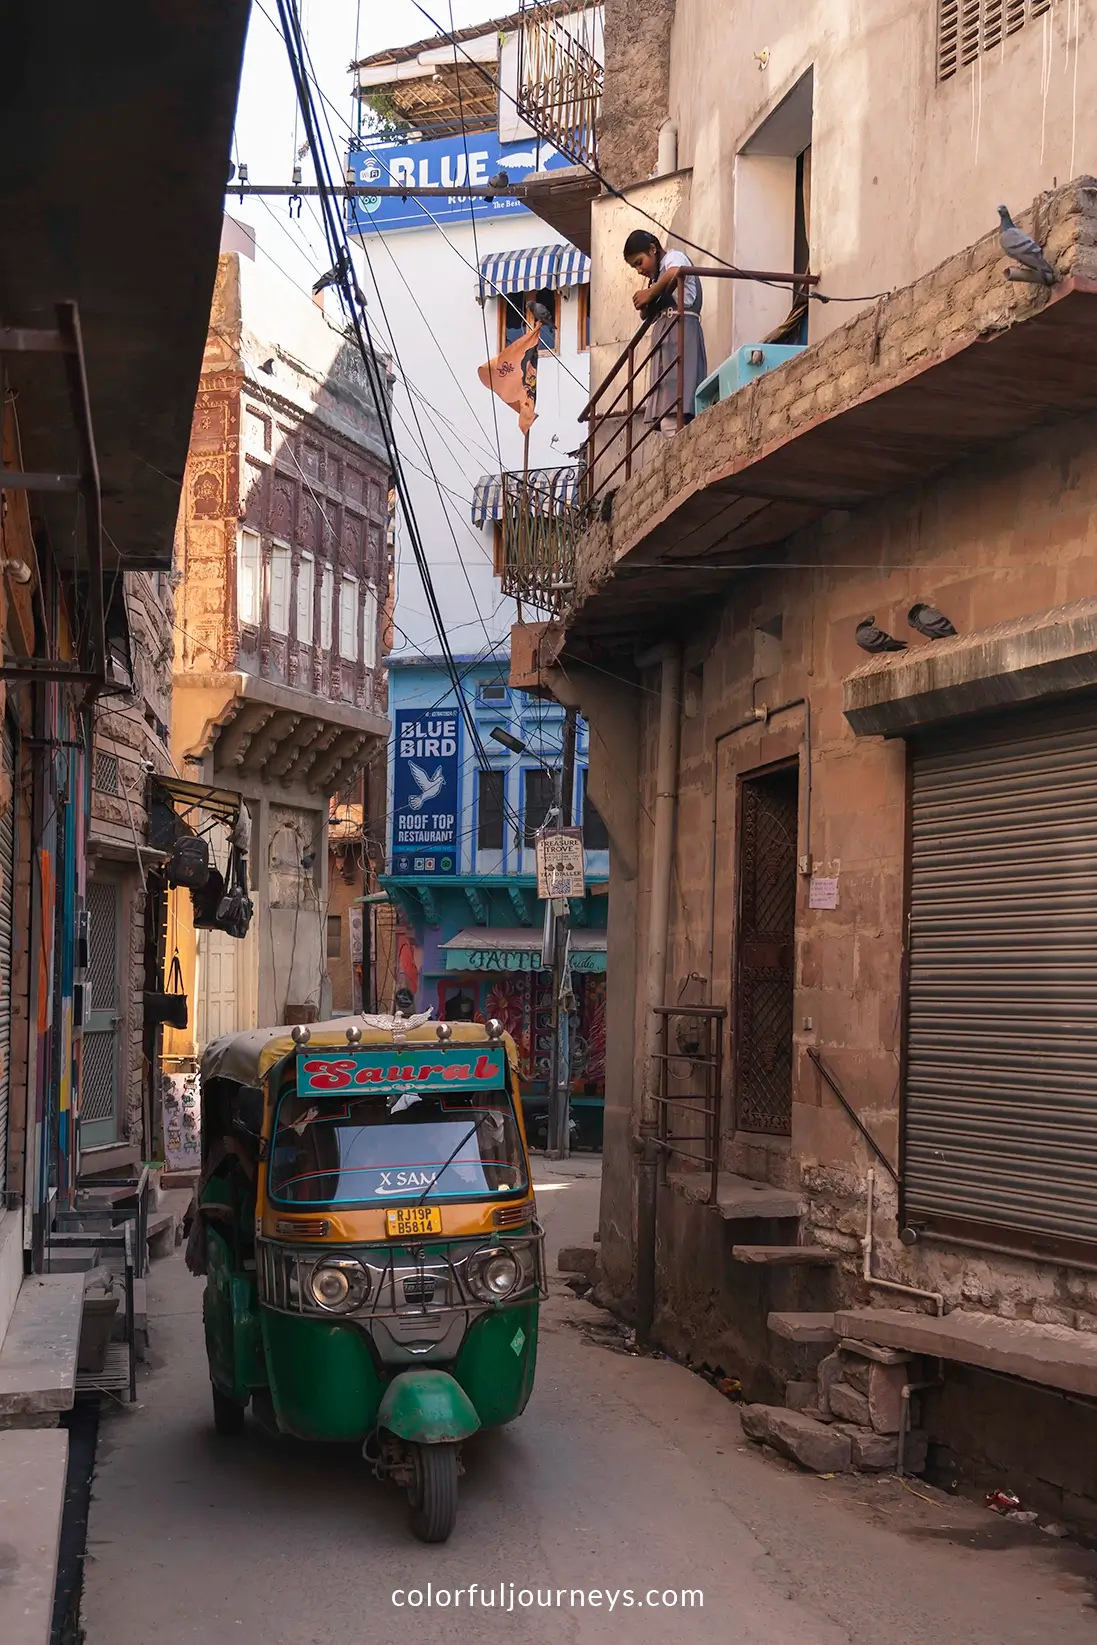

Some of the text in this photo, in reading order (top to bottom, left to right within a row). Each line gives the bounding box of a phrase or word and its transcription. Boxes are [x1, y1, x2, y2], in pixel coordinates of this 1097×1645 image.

[389, 151, 489, 188] BLUE
[493, 199, 521, 209] The Best
[401, 720, 456, 738] BLUE
[400, 739, 457, 757] BIRD
[398, 813, 454, 830] ROOF TOP
[398, 830, 454, 842] RESTAURANT
[540, 839, 580, 847] TREASURE
[468, 950, 553, 970] TATTO
[303, 1055, 500, 1089] Saurab
[380, 1171, 438, 1186] X SAM
[397, 1208, 432, 1221] RJ19P
[397, 1220, 433, 1234] B5814
